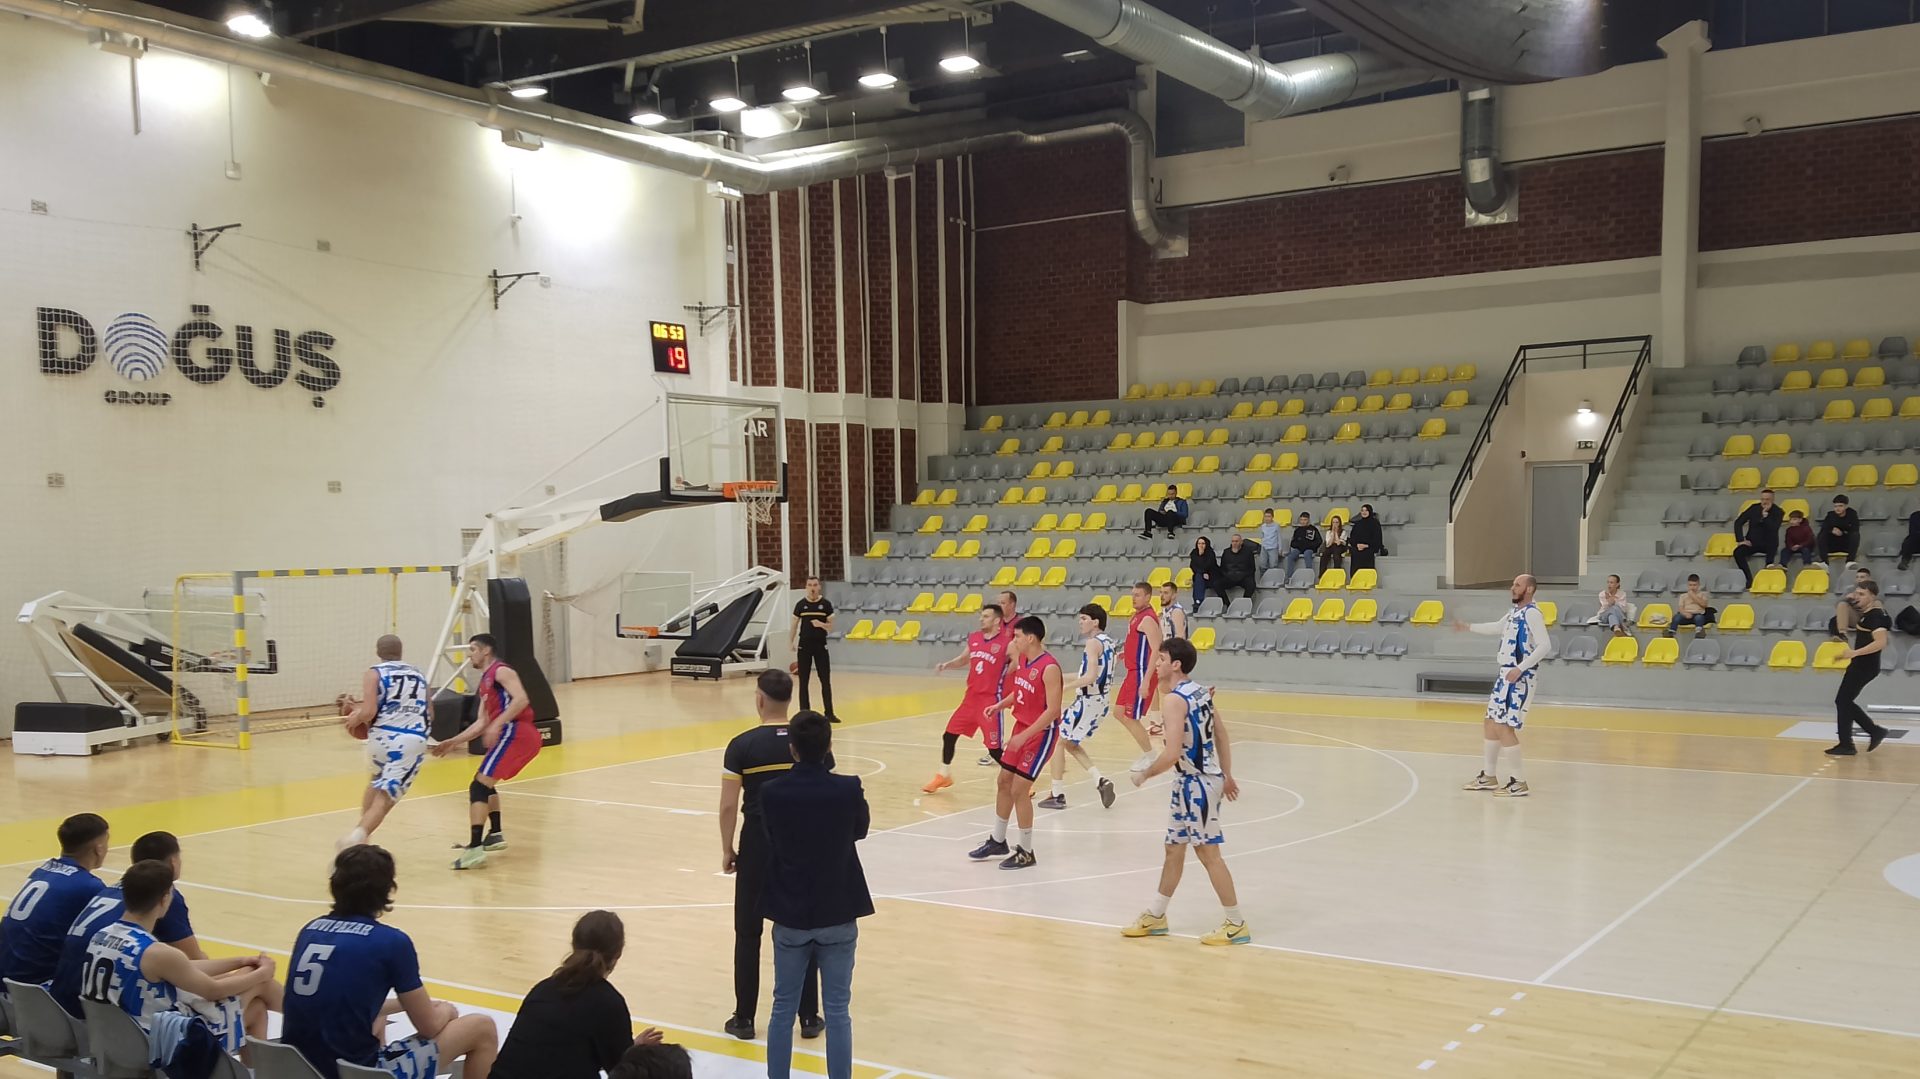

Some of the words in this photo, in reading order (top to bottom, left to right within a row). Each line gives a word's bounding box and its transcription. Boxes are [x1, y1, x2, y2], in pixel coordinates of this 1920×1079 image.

[667, 346, 686, 369] 19
[103, 390, 172, 406] GROUP
[974, 660, 985, 676] 4
[391, 674, 420, 700] 77
[1016, 689, 1025, 706] 2
[293, 942, 337, 996] 5
